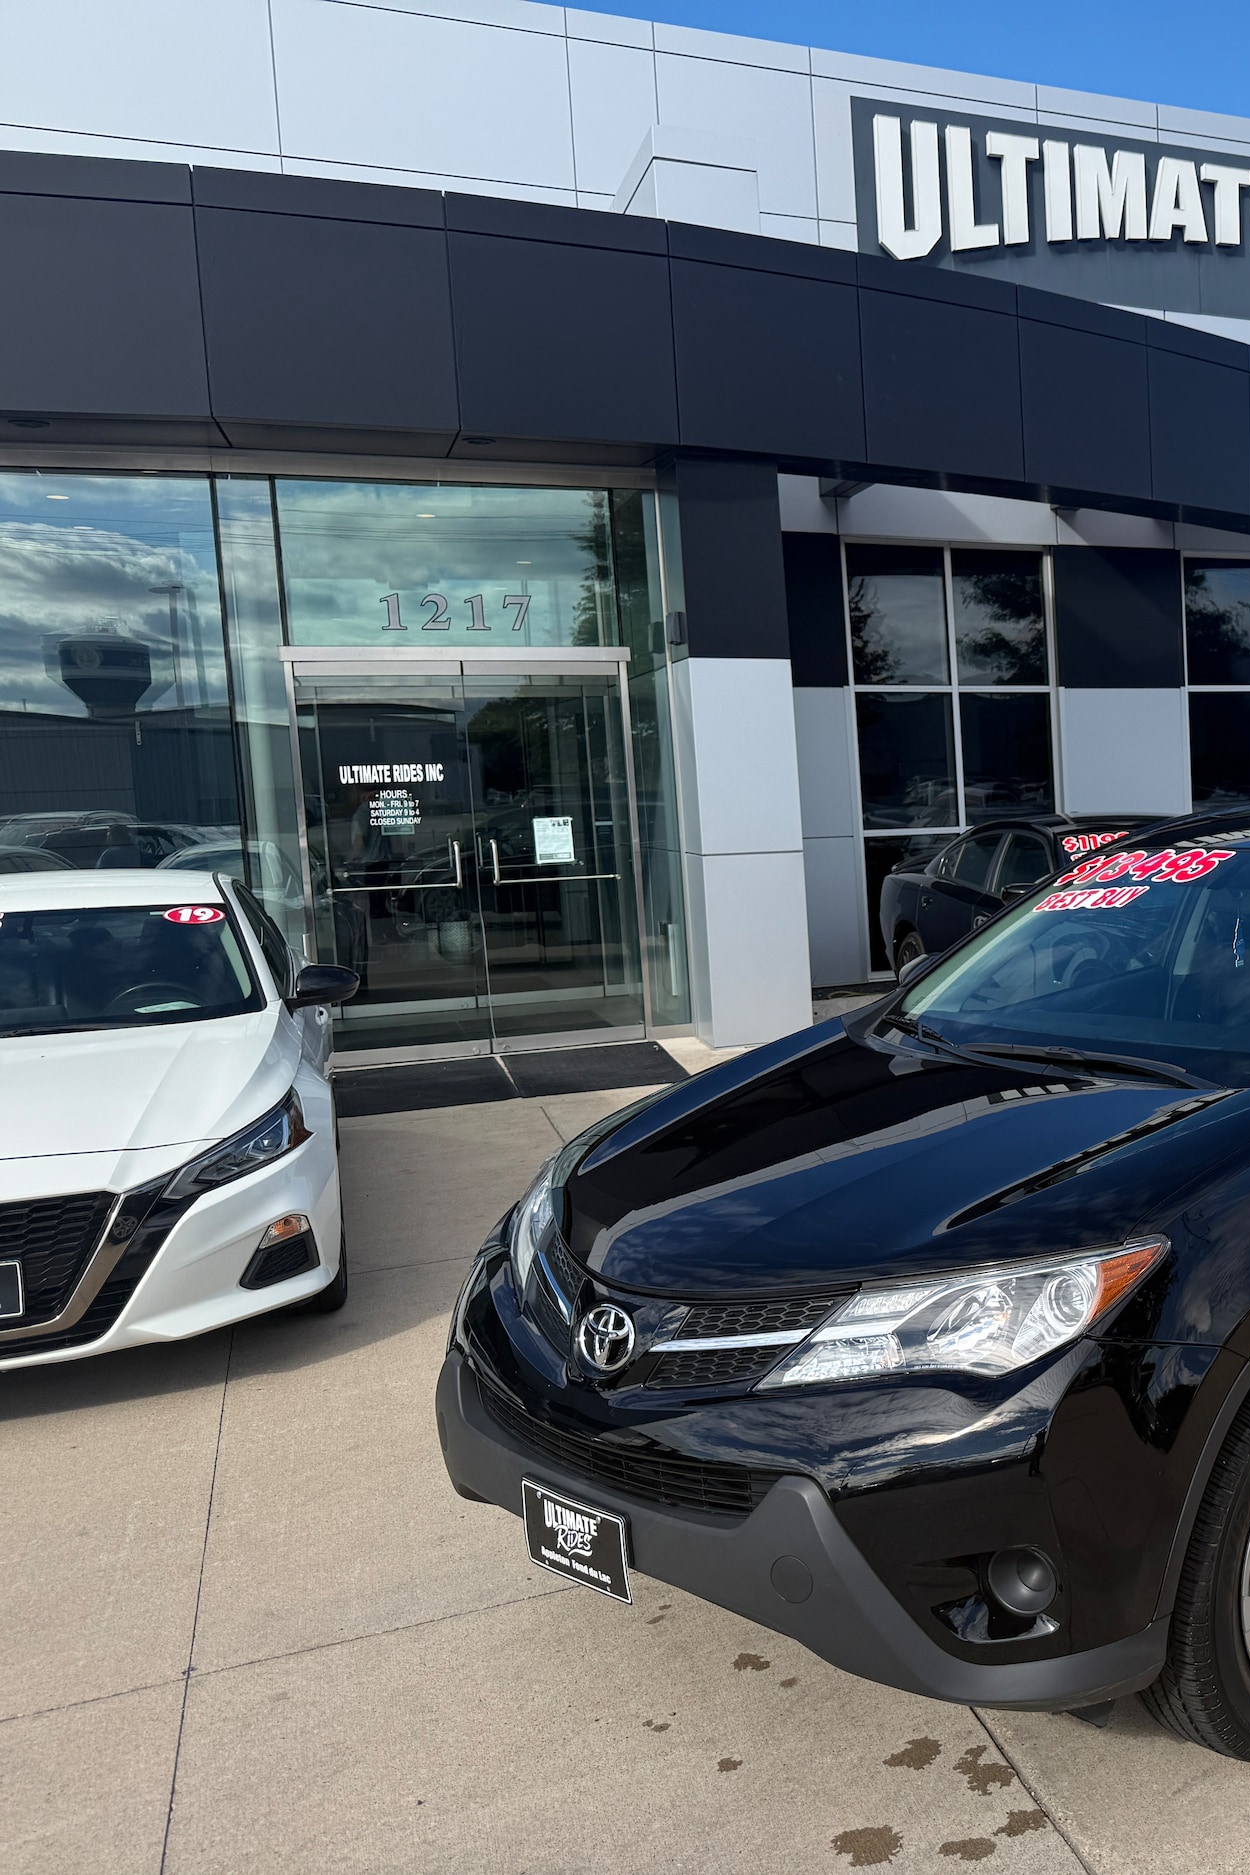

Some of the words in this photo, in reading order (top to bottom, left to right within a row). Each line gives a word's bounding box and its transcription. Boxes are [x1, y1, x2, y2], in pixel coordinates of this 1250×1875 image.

[379, 593, 531, 631] 1217
[340, 765, 392, 784] ULTIMATE
[392, 764, 424, 782] RIDES
[425, 763, 444, 782] INC
[380, 790, 407, 799] HOURS
[369, 801, 386, 809] MON.
[390, 800, 402, 808] FRI.
[370, 809, 402, 817] SATURDAY
[370, 818, 396, 826] CLOSED
[396, 817, 421, 825] SUNDAY
[1053, 849, 1236, 886] $13495
[1033, 888, 1096, 912] BEST
[1091, 886, 1150, 909] BUY
[177, 907, 215, 922] 19
[544, 1499, 597, 1536] ULTIMATE
